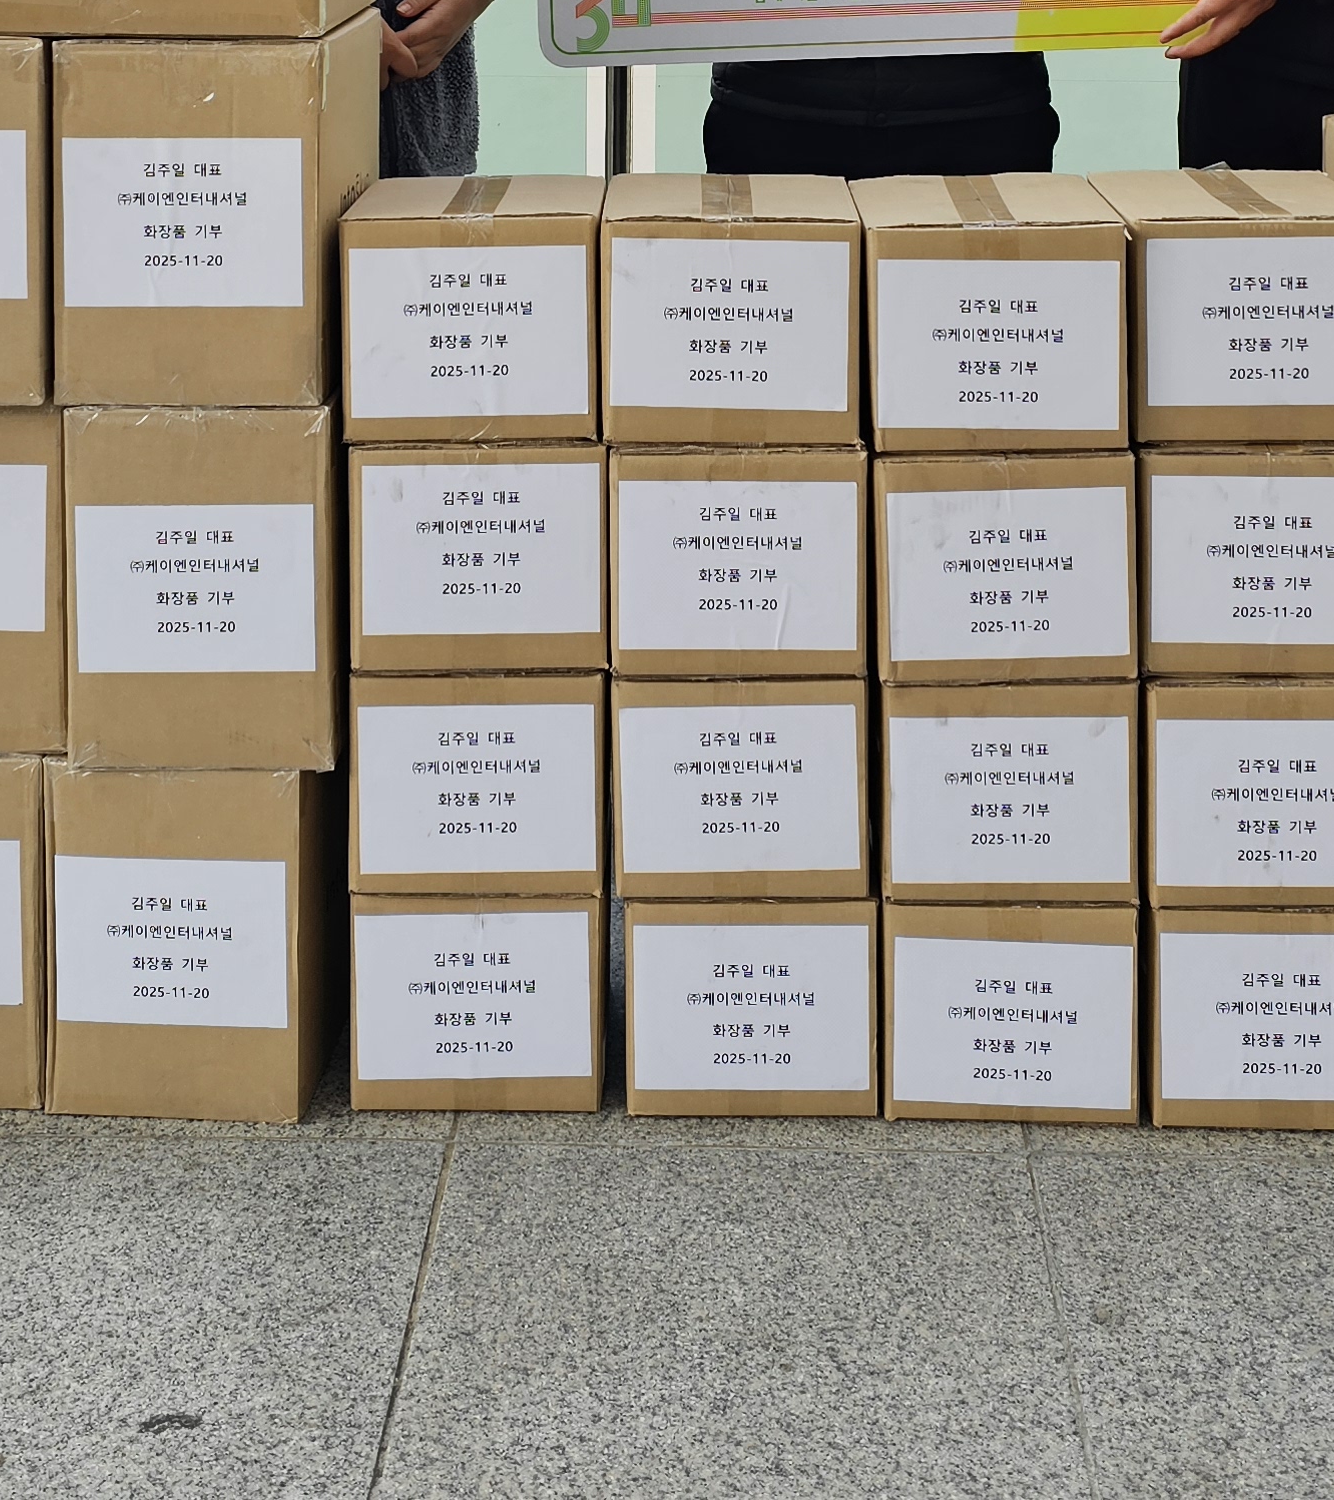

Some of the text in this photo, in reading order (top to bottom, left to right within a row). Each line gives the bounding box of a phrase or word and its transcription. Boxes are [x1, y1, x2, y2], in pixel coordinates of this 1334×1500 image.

[144, 163, 221, 177] 김주일 대표
[144, 224, 222, 239] 화장품 기부
[145, 255, 222, 266] 2025-11-20
[691, 278, 768, 293] 김주일 대표
[959, 299, 1038, 314] 김주일 대표
[689, 339, 767, 354] 화장품 기부
[958, 361, 1038, 375] 화장품 기부
[690, 370, 767, 382] 2025-11-20
[959, 391, 1038, 402] 2025-11-20
[443, 491, 520, 505] 김주일 대표
[156, 530, 234, 544] 김주일 대표
[969, 529, 1047, 544] 김주일 대표
[442, 552, 521, 567] 화장품 기부
[442, 583, 521, 594] 2025-11-20
[156, 591, 234, 605] 화장품 기부
[970, 590, 1049, 605] 화장품 기부
[158, 621, 235, 632] 2025-11-20
[971, 620, 1049, 632] 2025-11-20
[700, 731, 777, 747] 김주일 대표
[1238, 759, 1317, 774] 김주일 대표
[701, 792, 778, 807] 화장품 기부
[702, 821, 779, 834] 2025-11-20
[1237, 820, 1317, 834] 화장품 기부
[1238, 850, 1316, 861] 2025-11-20
[132, 897, 207, 912] 김주일 대표
[132, 957, 208, 972] 화장품 기부
[434, 952, 510, 967] 김주일 대표
[133, 986, 209, 999] 2025-11-20
[434, 1012, 512, 1026] 화장품 기부
[436, 1041, 513, 1053] 2025-11-20
